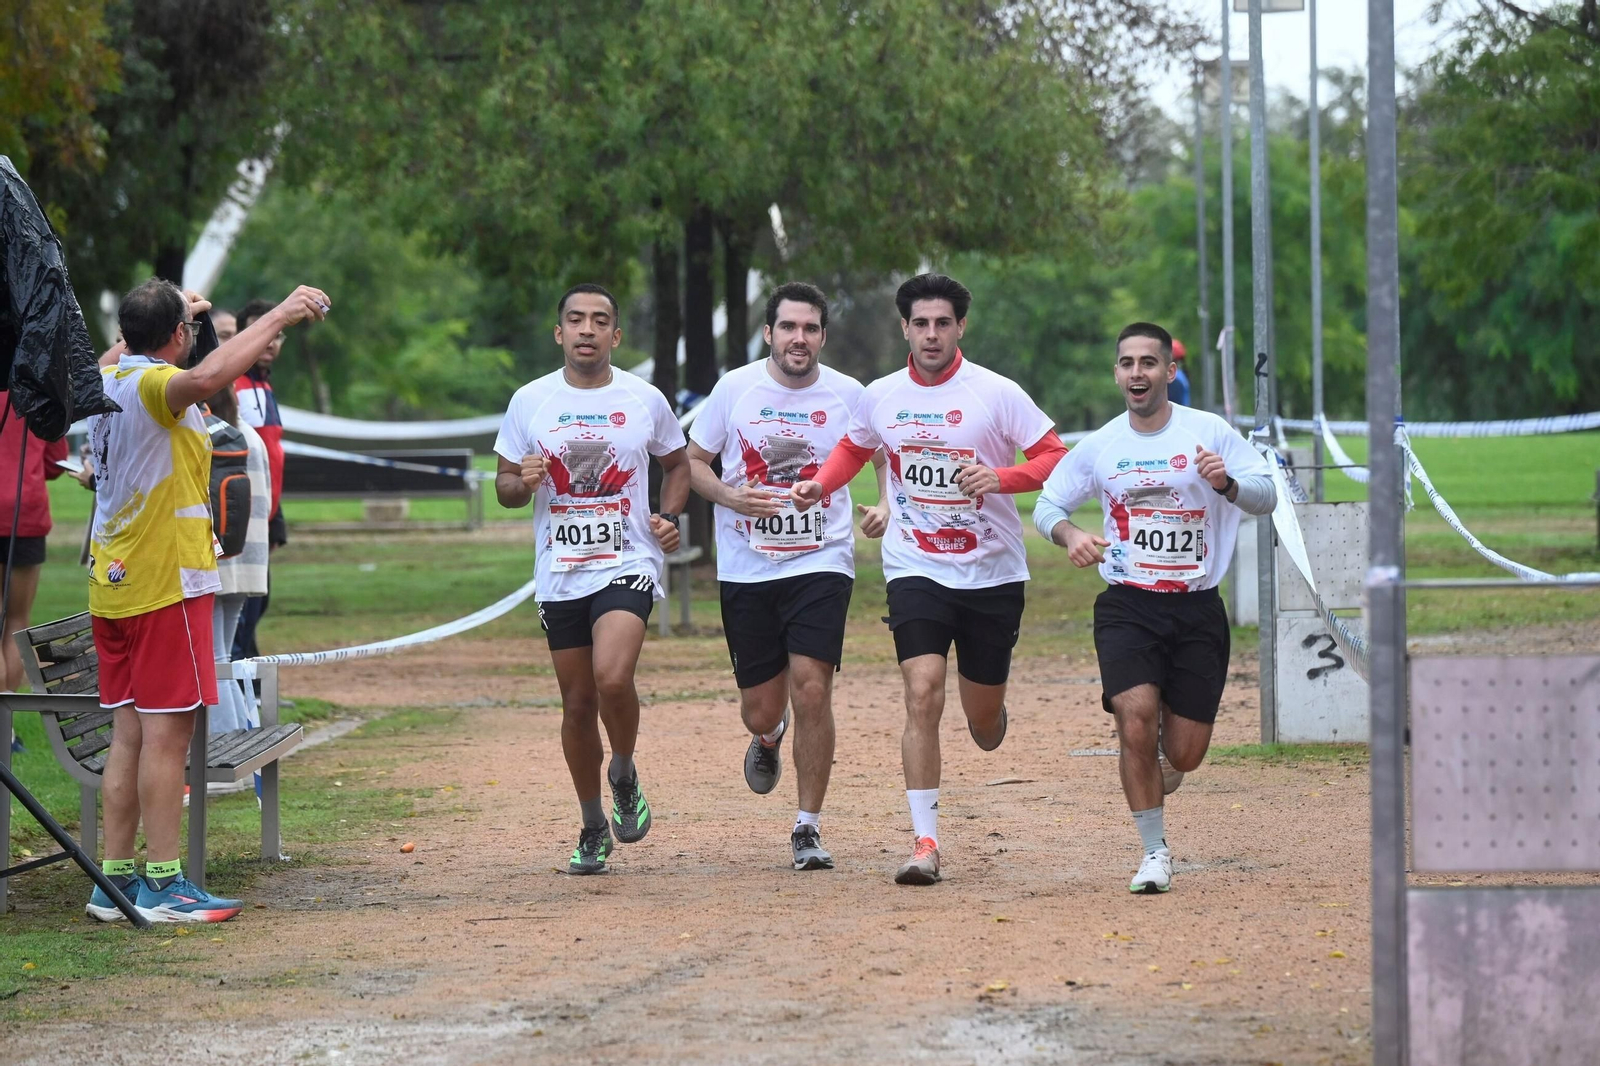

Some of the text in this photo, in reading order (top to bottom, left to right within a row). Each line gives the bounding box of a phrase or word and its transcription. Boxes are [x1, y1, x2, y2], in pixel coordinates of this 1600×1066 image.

[611, 415, 625, 425] aje
[811, 413, 826, 424] aje
[946, 412, 962, 422] aje
[1170, 456, 1187, 467] aje
[905, 464, 962, 488] 4014
[754, 513, 812, 535] 4011
[555, 522, 611, 546] 4013
[926, 536, 967, 544] RUNNNG
[1133, 529, 1193, 553] 4012
[935, 542, 965, 551] SERIES
[1300, 633, 1345, 681] 3
